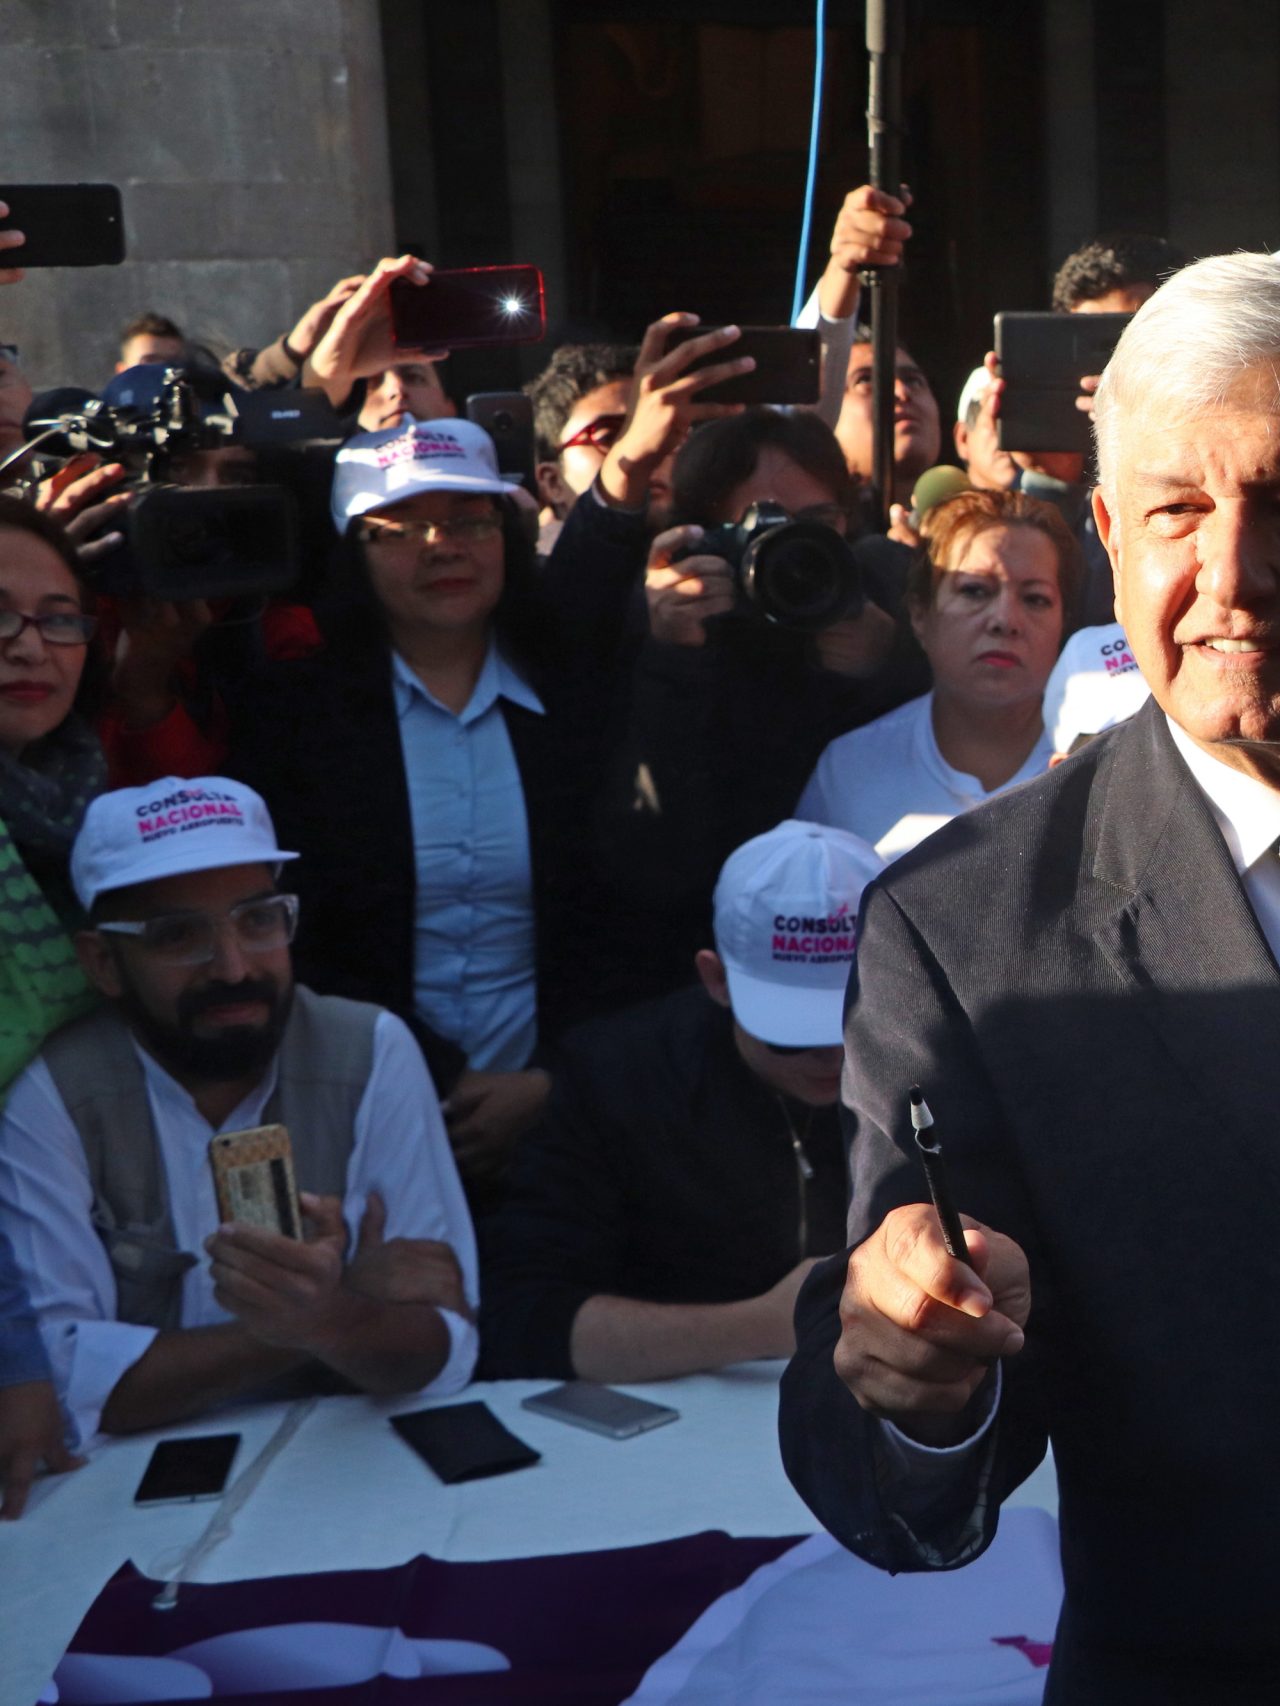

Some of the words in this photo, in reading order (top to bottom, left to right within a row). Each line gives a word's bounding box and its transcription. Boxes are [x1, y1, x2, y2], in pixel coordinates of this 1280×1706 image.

[136, 789, 238, 817] CONSULTA
[138, 803, 243, 833] NACIONAL
[773, 914, 857, 934] CONSULT
